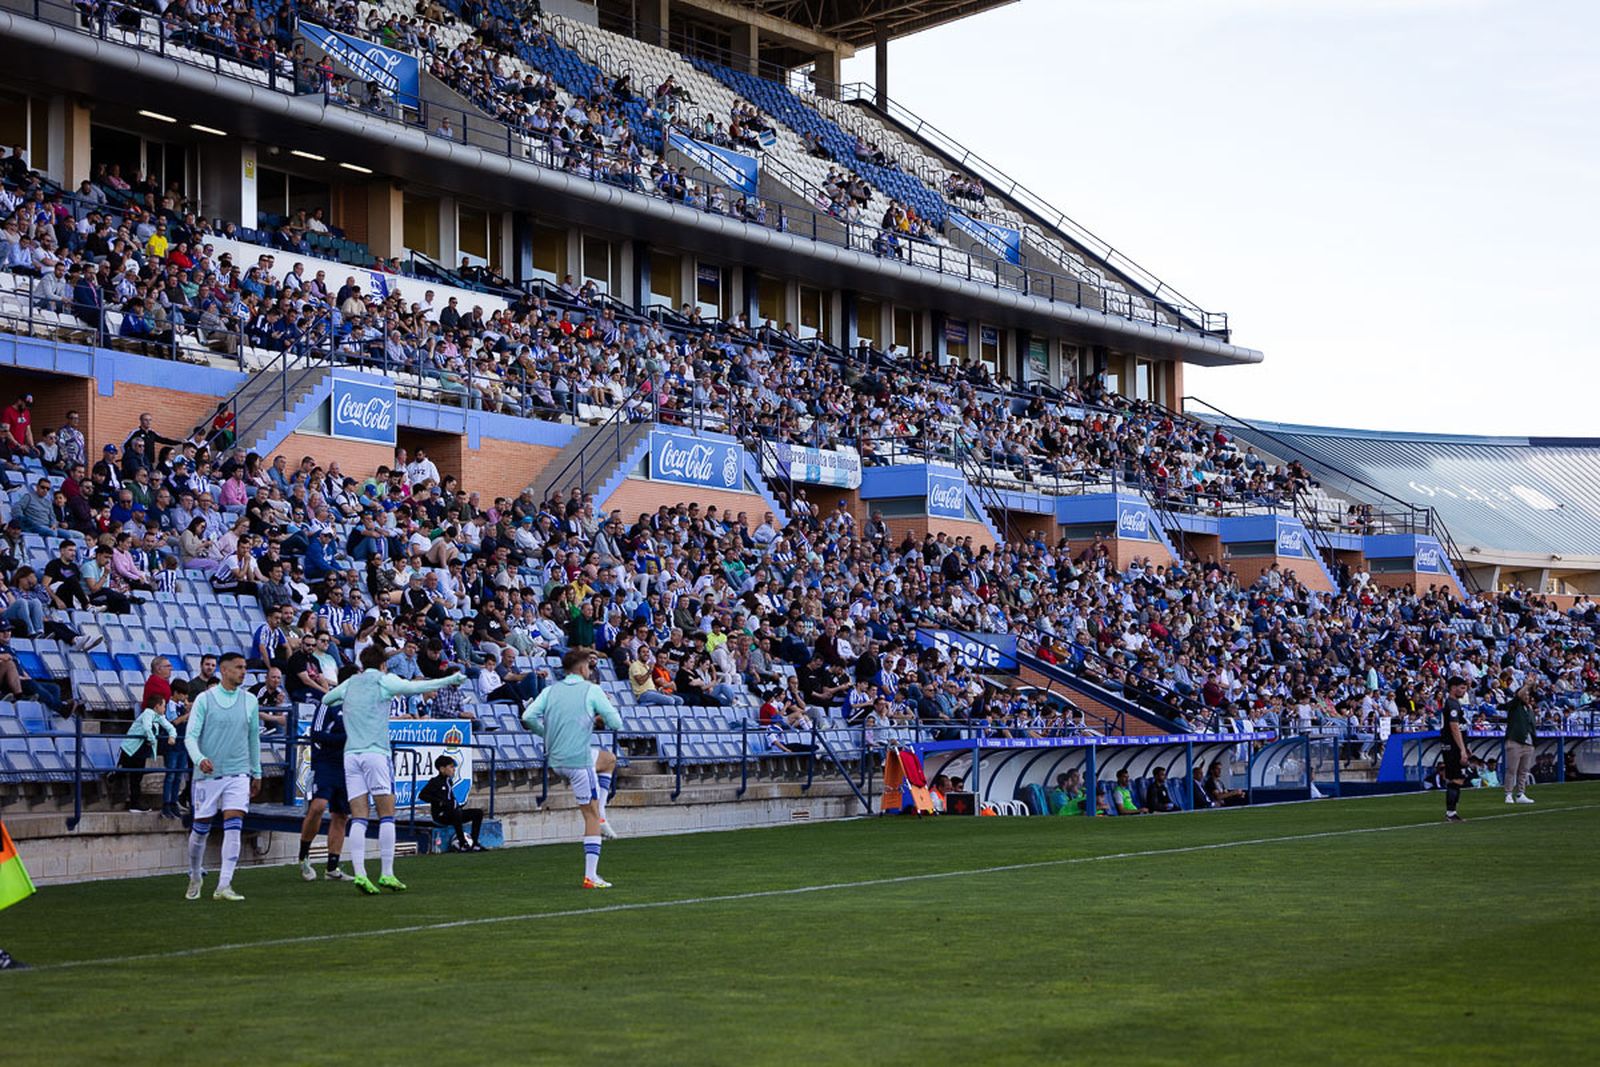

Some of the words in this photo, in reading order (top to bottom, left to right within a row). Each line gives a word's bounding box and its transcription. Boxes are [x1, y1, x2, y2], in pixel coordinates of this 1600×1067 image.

[337, 393, 393, 430] Coca-Cola
[660, 440, 715, 480] Coca-Cola
[931, 484, 962, 509] Coca-Cola
[1120, 509, 1146, 531] Coca-Cola
